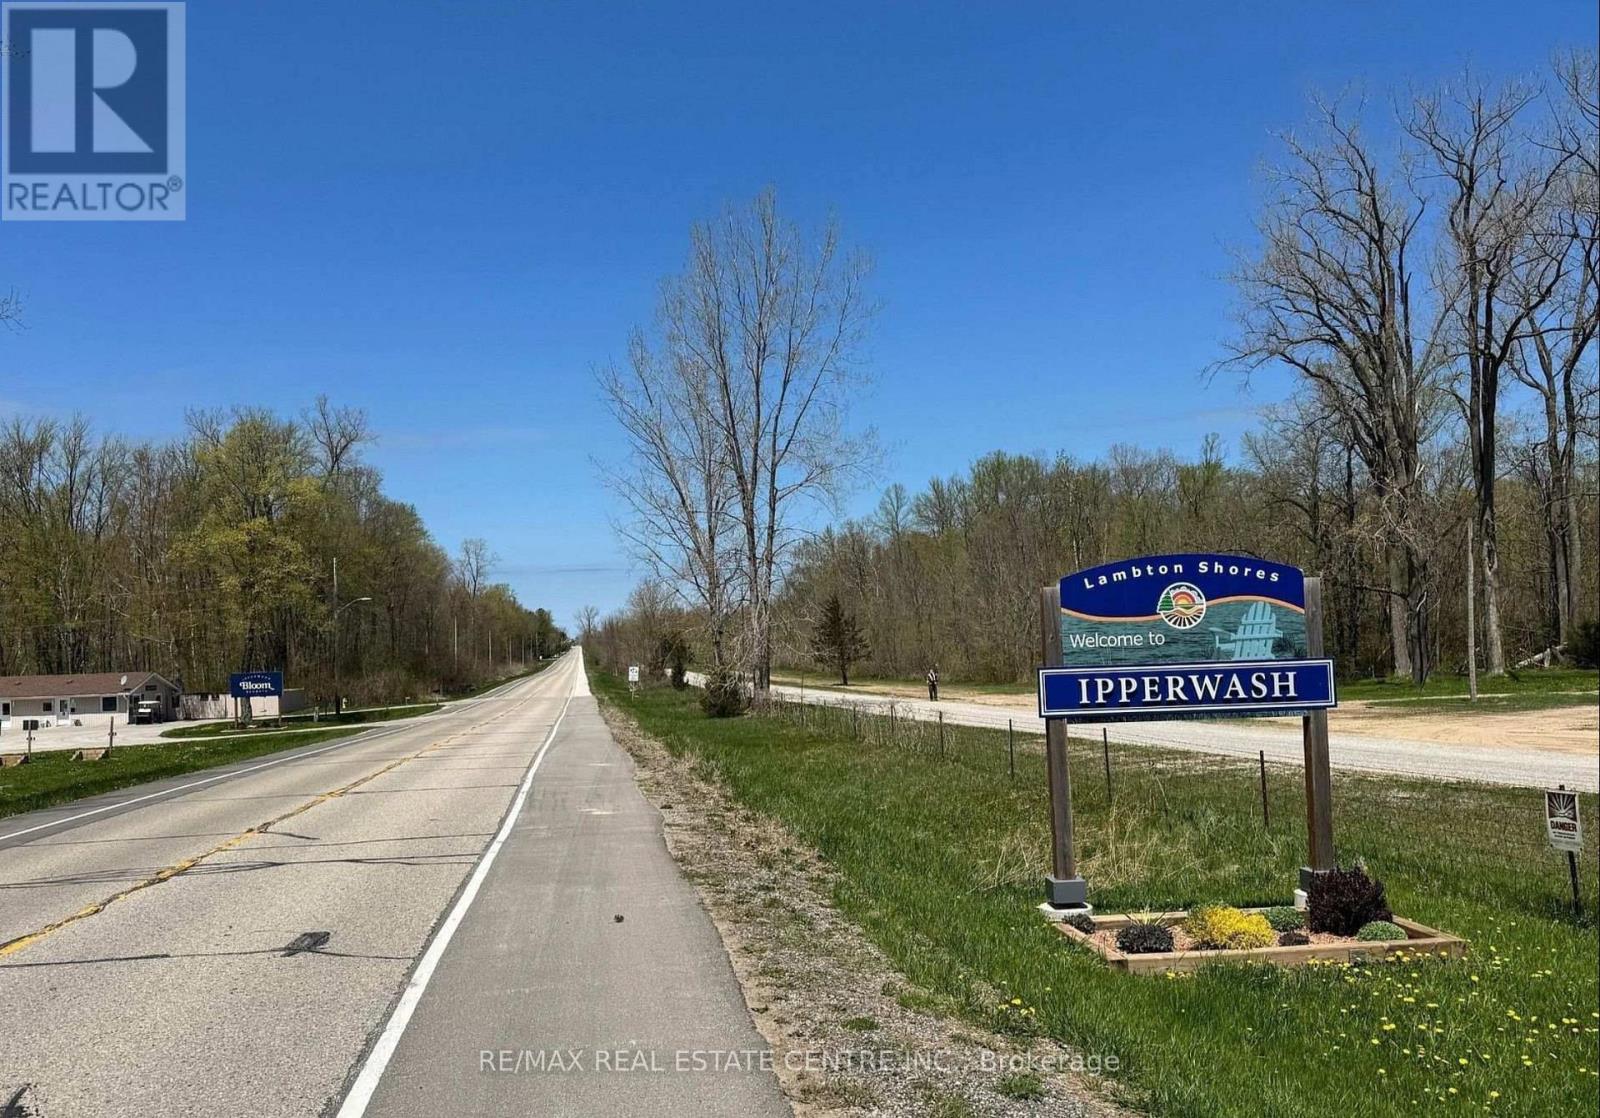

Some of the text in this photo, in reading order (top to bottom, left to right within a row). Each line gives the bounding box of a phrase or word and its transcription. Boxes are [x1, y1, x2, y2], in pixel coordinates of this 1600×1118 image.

[1083, 561, 1281, 590] Lambton Shores
[1069, 631, 1165, 649] Welcome to
[239, 681, 275, 690] Bloom
[1078, 671, 1298, 705] IPPERWASH
[1550, 820, 1577, 832] DANGER
